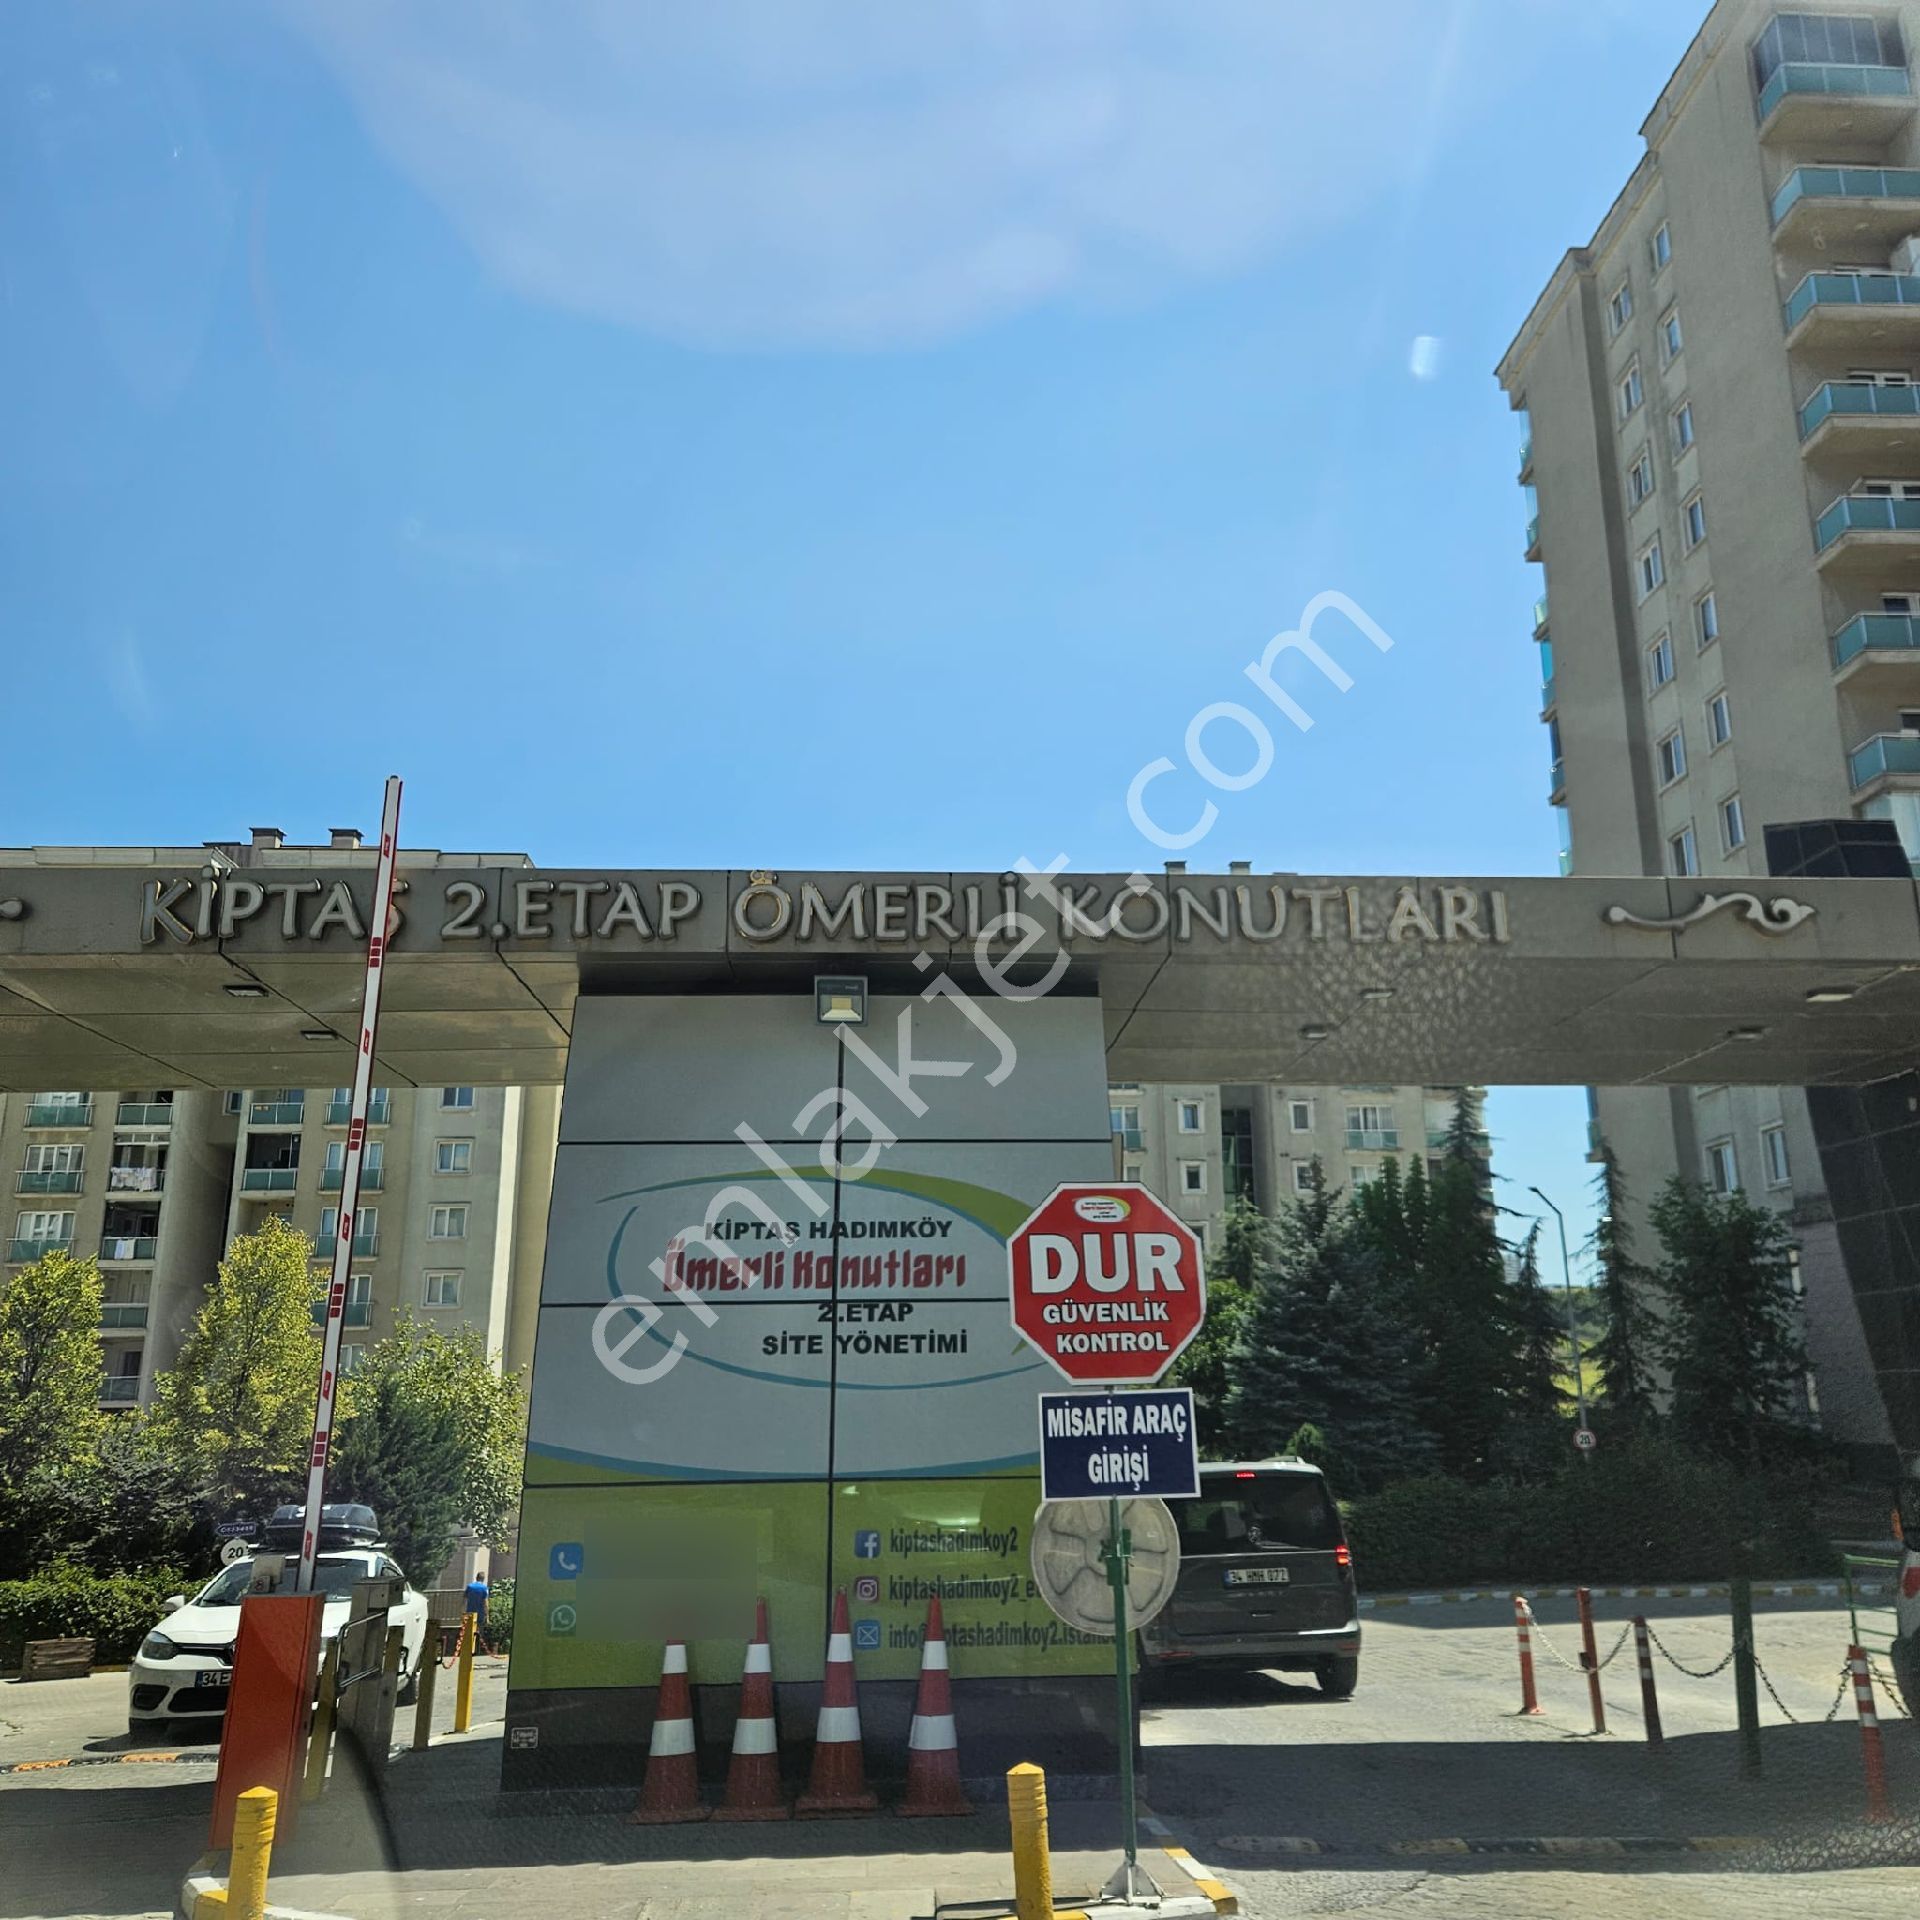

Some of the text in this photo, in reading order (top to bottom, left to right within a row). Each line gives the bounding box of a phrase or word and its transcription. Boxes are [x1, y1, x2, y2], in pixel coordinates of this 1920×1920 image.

[440, 877, 701, 940] 2.ETAP
[733, 869, 1023, 943] ÖMERLİ
[1059, 882, 1509, 944] KONUTLARI
[705, 1217, 953, 1245] KİPTAŞ HADIMKÖY
[793, 1249, 966, 1290] Konutları
[1028, 1232, 1186, 1295] DUR
[817, 1303, 914, 1323] 2.ETAP
[1043, 1297, 1170, 1324] GÜVENLİK
[762, 1329, 968, 1355] SİTE YÖNETİMİ
[1056, 1331, 1170, 1354] KONTROL
[1047, 1399, 1187, 1443] MİSAFİR ARAÇ
[1087, 1444, 1150, 1491] GİRİŞİ
[227, 1546, 244, 1559] 20
[890, 1526, 1018, 1560] kiptashadimkoy2
[203, 1672, 218, 1686] 34
